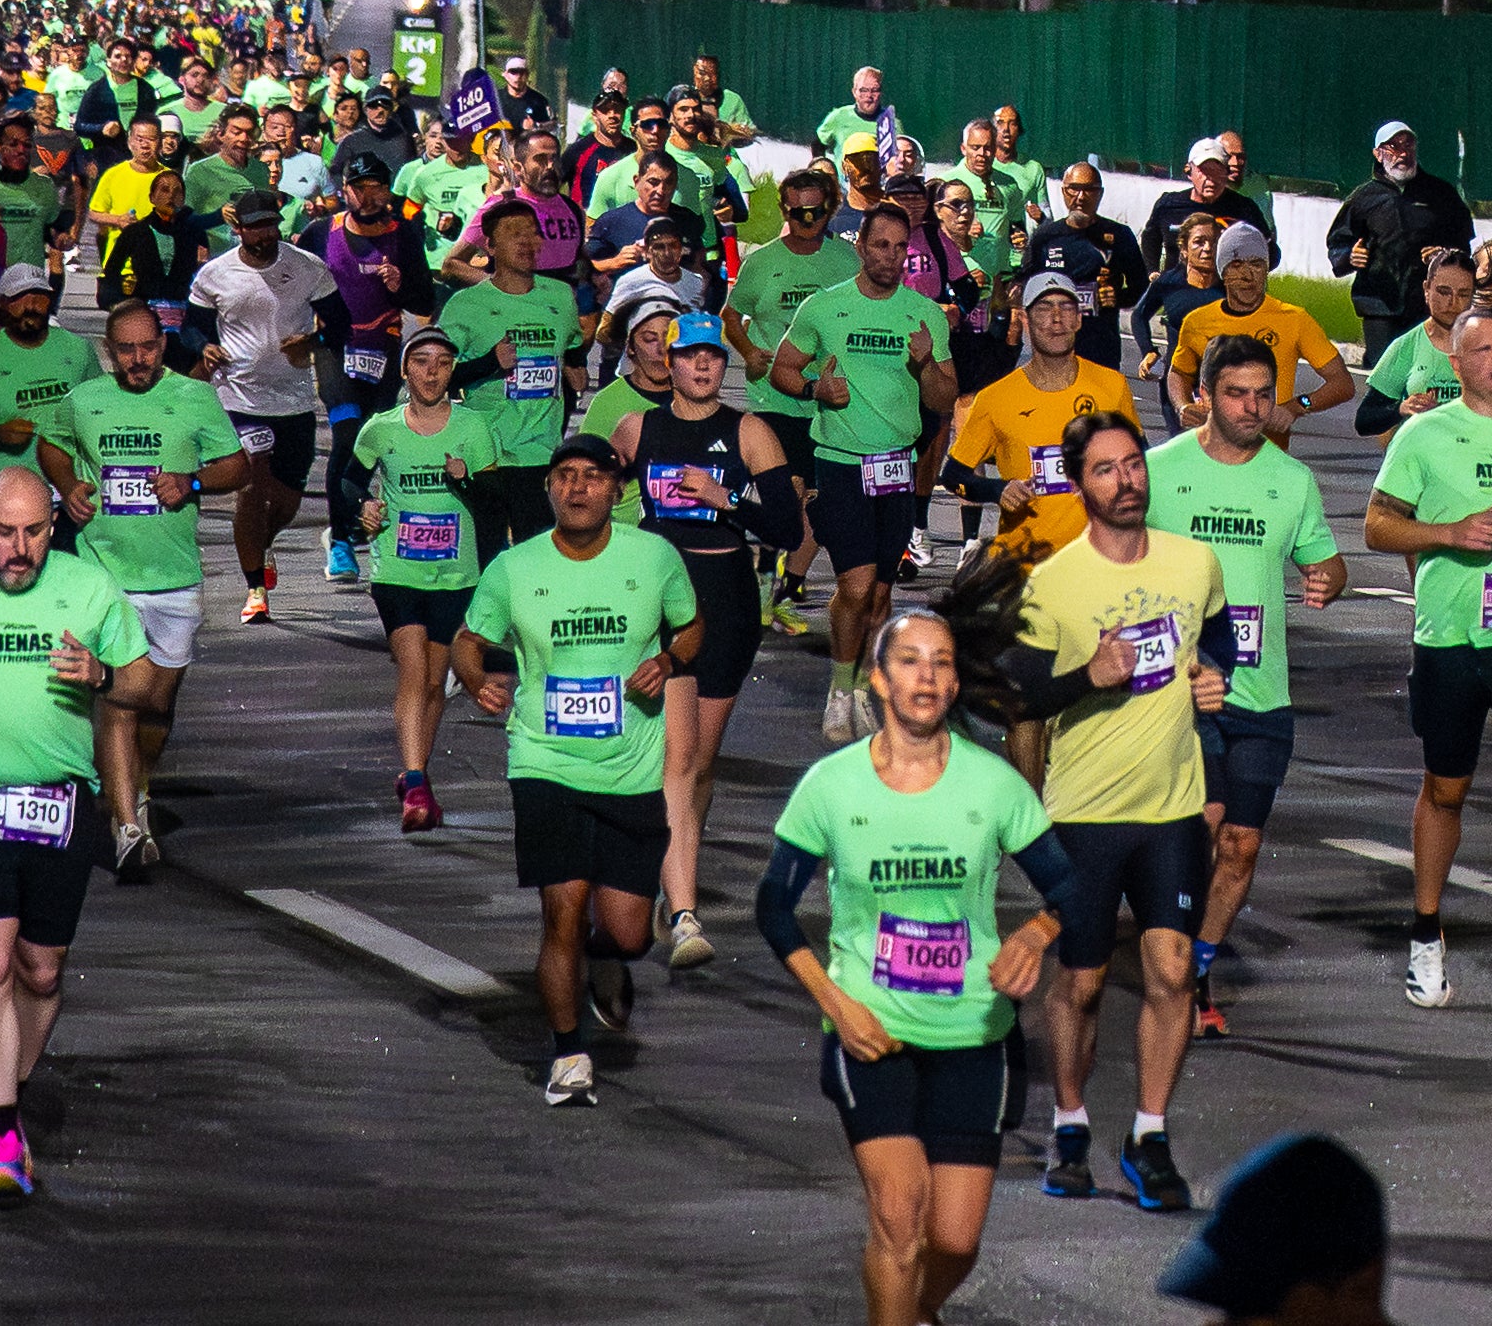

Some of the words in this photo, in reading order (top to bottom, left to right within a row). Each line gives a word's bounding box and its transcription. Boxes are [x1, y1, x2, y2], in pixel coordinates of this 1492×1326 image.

[400, 35, 437, 54] KM
[404, 56, 427, 86] 2
[456, 86, 485, 112] 1:40
[544, 217, 579, 241] CER
[845, 331, 905, 350] ATHENAS
[521, 367, 554, 385] 2740
[99, 432, 163, 450] ATHENAS
[399, 472, 450, 489] ATHENA
[882, 463, 904, 478] 841
[116, 480, 153, 498] 1515
[414, 526, 451, 543] 2748
[1190, 515, 1267, 539] ATHENAS
[550, 614, 628, 639] ATHENAS
[563, 695, 612, 716] 2910
[16, 800, 60, 824] 1310
[868, 856, 968, 883] ATHENAS
[904, 943, 964, 970] 1060
